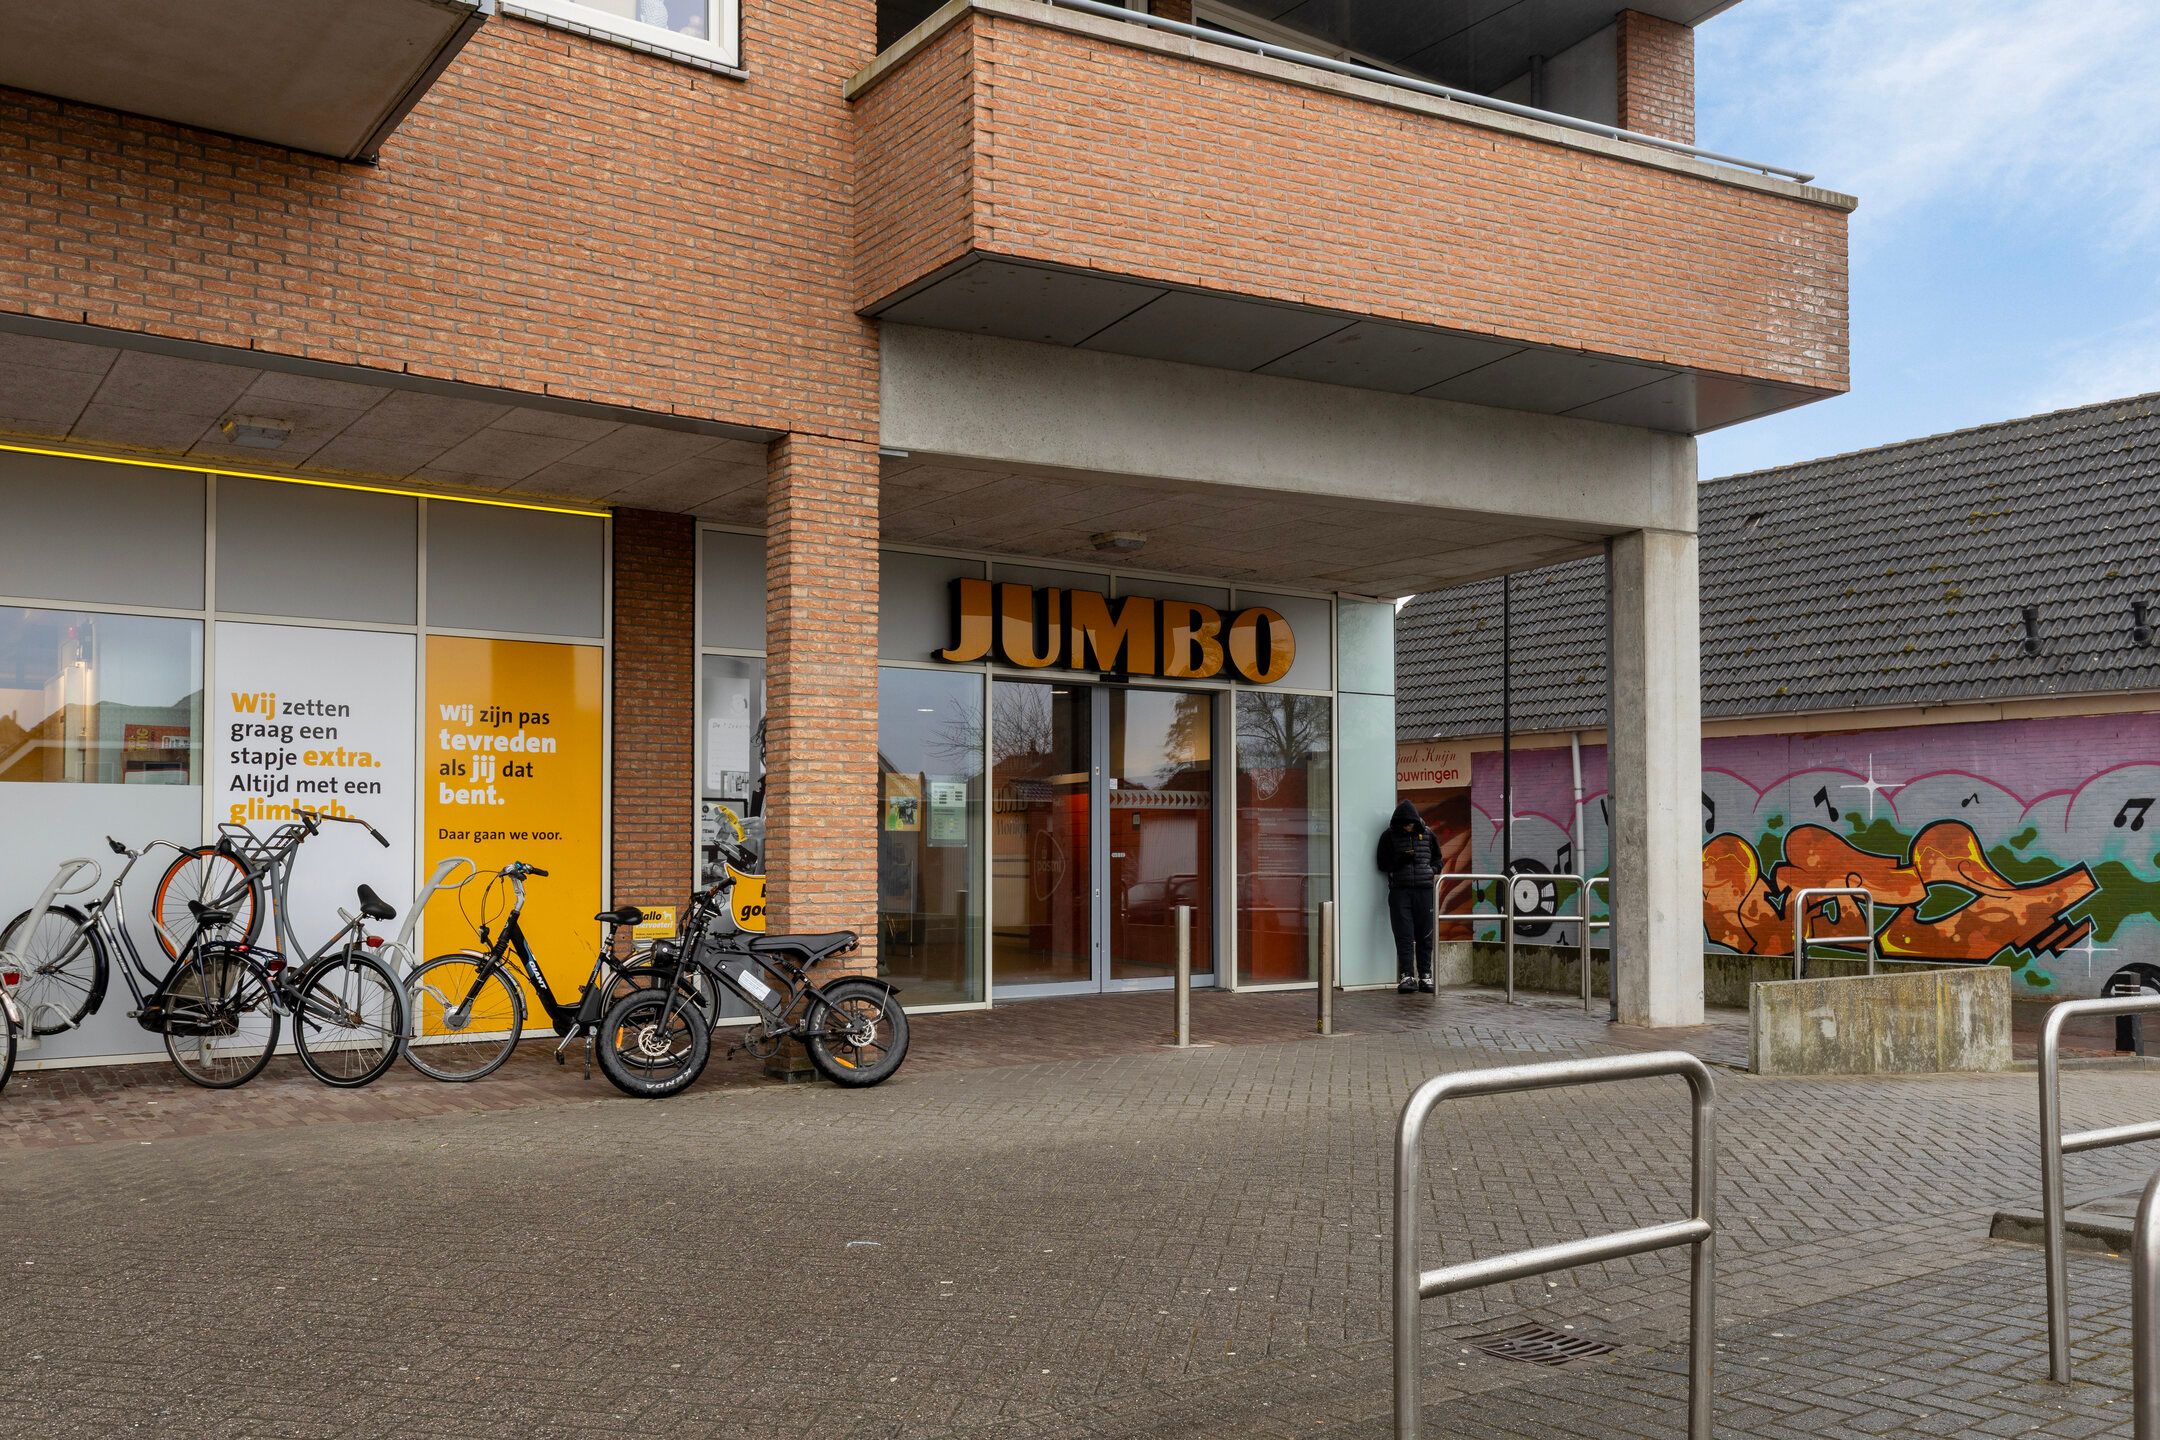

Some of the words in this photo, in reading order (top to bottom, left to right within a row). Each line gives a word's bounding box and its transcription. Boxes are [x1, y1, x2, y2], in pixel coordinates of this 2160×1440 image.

[939, 577, 1296, 684] JUMBO
[231, 692, 276, 720] Wij
[282, 699, 350, 717] zetten
[440, 704, 474, 726] Wij
[480, 706, 512, 728] zijn
[519, 711, 550, 728] pas
[231, 723, 293, 743] graag
[300, 726, 337, 739] een
[439, 729, 556, 753] tevreden
[230, 748, 297, 770] stapje
[303, 747, 381, 768] extra.
[440, 759, 466, 776] als
[470, 755, 495, 783] jij
[502, 761, 533, 777] dat
[230, 774, 289, 797] Altijd
[296, 777, 338, 793] met
[344, 781, 381, 794] een
[440, 782, 505, 805] bent.
[439, 828, 470, 840] Daar
[474, 831, 505, 843] gaan
[510, 832, 528, 840] we
[532, 831, 562, 840] voor.
[641, 911, 662, 920] allo
[529, 961, 547, 990] GIANT
[645, 1067, 693, 1089] KENDA
